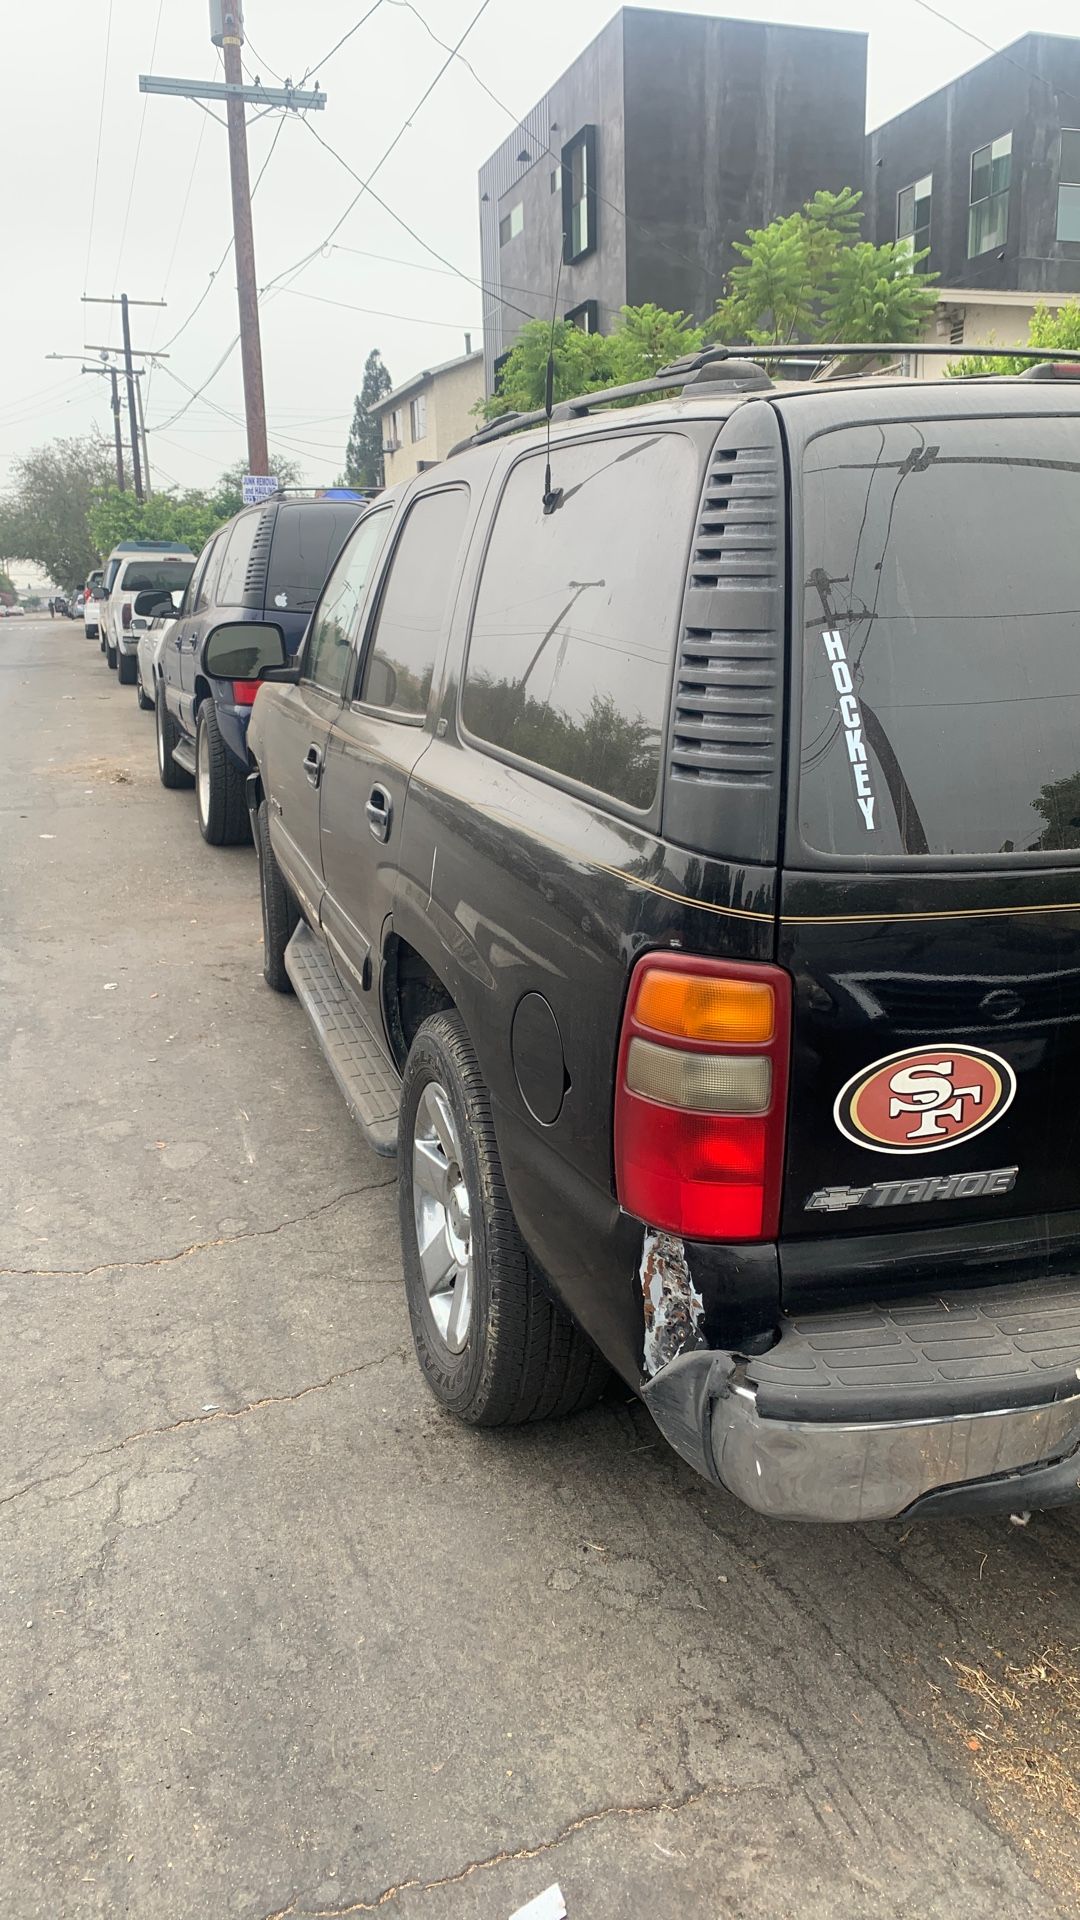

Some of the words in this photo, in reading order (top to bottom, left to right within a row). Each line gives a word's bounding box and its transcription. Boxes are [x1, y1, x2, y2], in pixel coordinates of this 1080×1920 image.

[243, 478, 255, 486] JUNK
[256, 477, 277, 486] REMOVAL
[245, 487, 254, 495] and
[821, 630, 875, 830] HOCKEY
[889, 1061, 983, 1139] SF
[871, 1165, 1019, 1207] TAHOE
